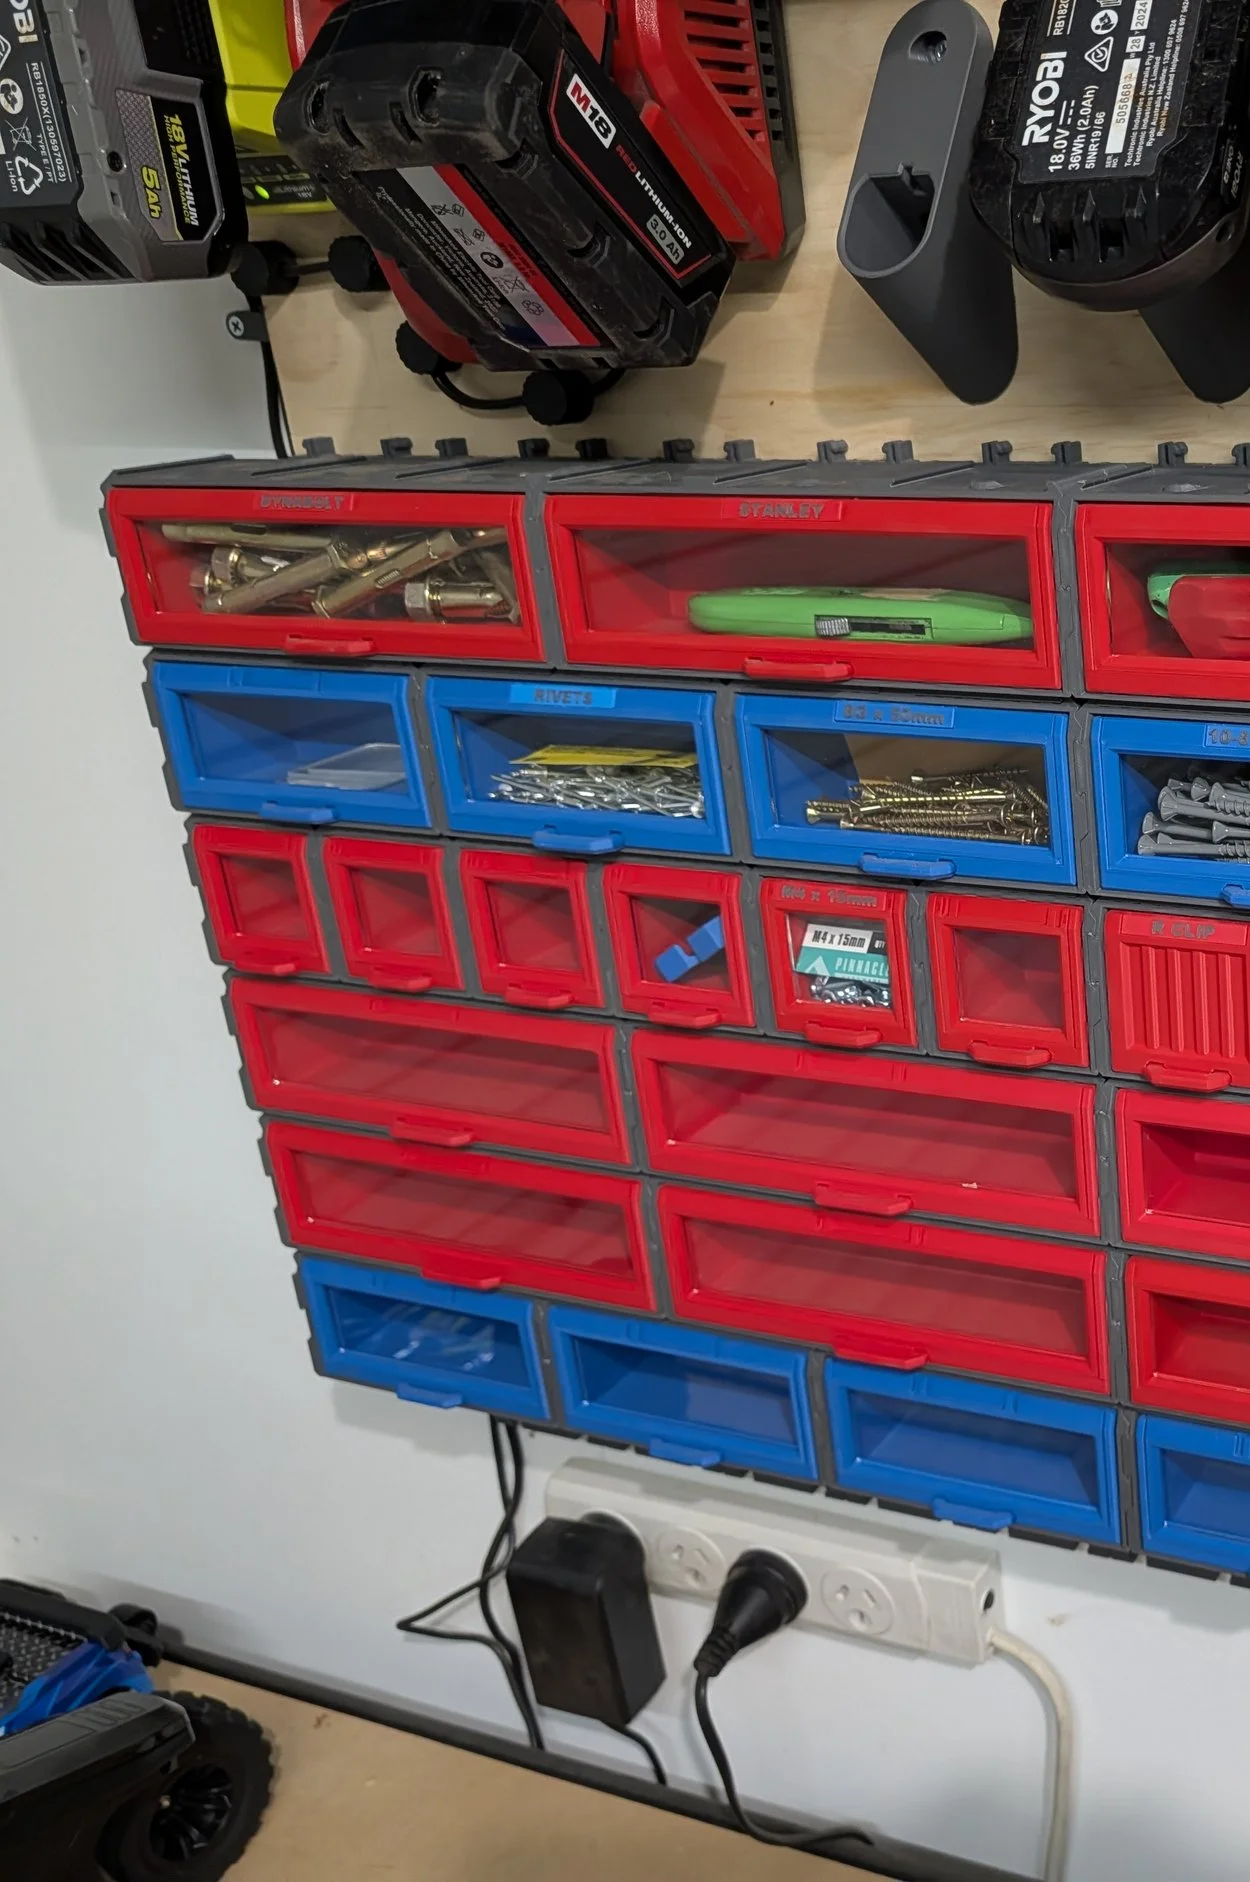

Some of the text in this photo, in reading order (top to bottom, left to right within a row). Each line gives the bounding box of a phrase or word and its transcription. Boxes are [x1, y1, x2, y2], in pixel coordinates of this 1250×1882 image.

[1135, 1, 1148, 27] 2024
[1130, 38, 1142, 50] 28
[1147, 42, 1156, 54] Ltd
[1145, 55, 1154, 65] Pty
[1139, 67, 1151, 96] Australia
[1164, 74, 1175, 100] Zealand
[570, 82, 613, 140] M18
[1021, 51, 1067, 146] RYOBI
[1161, 101, 1170, 115] New
[1068, 85, 1100, 170] 36Wh (2.0Ah)
[1146, 127, 1156, 147] Ryobi
[1156, 116, 1166, 137] Ryobi
[36, 134, 47, 157] TYPE
[1048, 128, 1070, 173] 18.0V
[1124, 131, 1137, 167] Techtronic
[1133, 131, 1146, 167] Techtronic
[141, 165, 161, 219] 5Ah
[171, 145, 191, 224] PERFORMANCE
[650, 219, 682, 260] 3.0 Ah
[739, 502, 825, 518] STANLEY
[534, 688, 592, 705] RIVETS
[812, 930, 867, 948] M4 x 15mm
[1151, 919, 1216, 940] R CLIP
